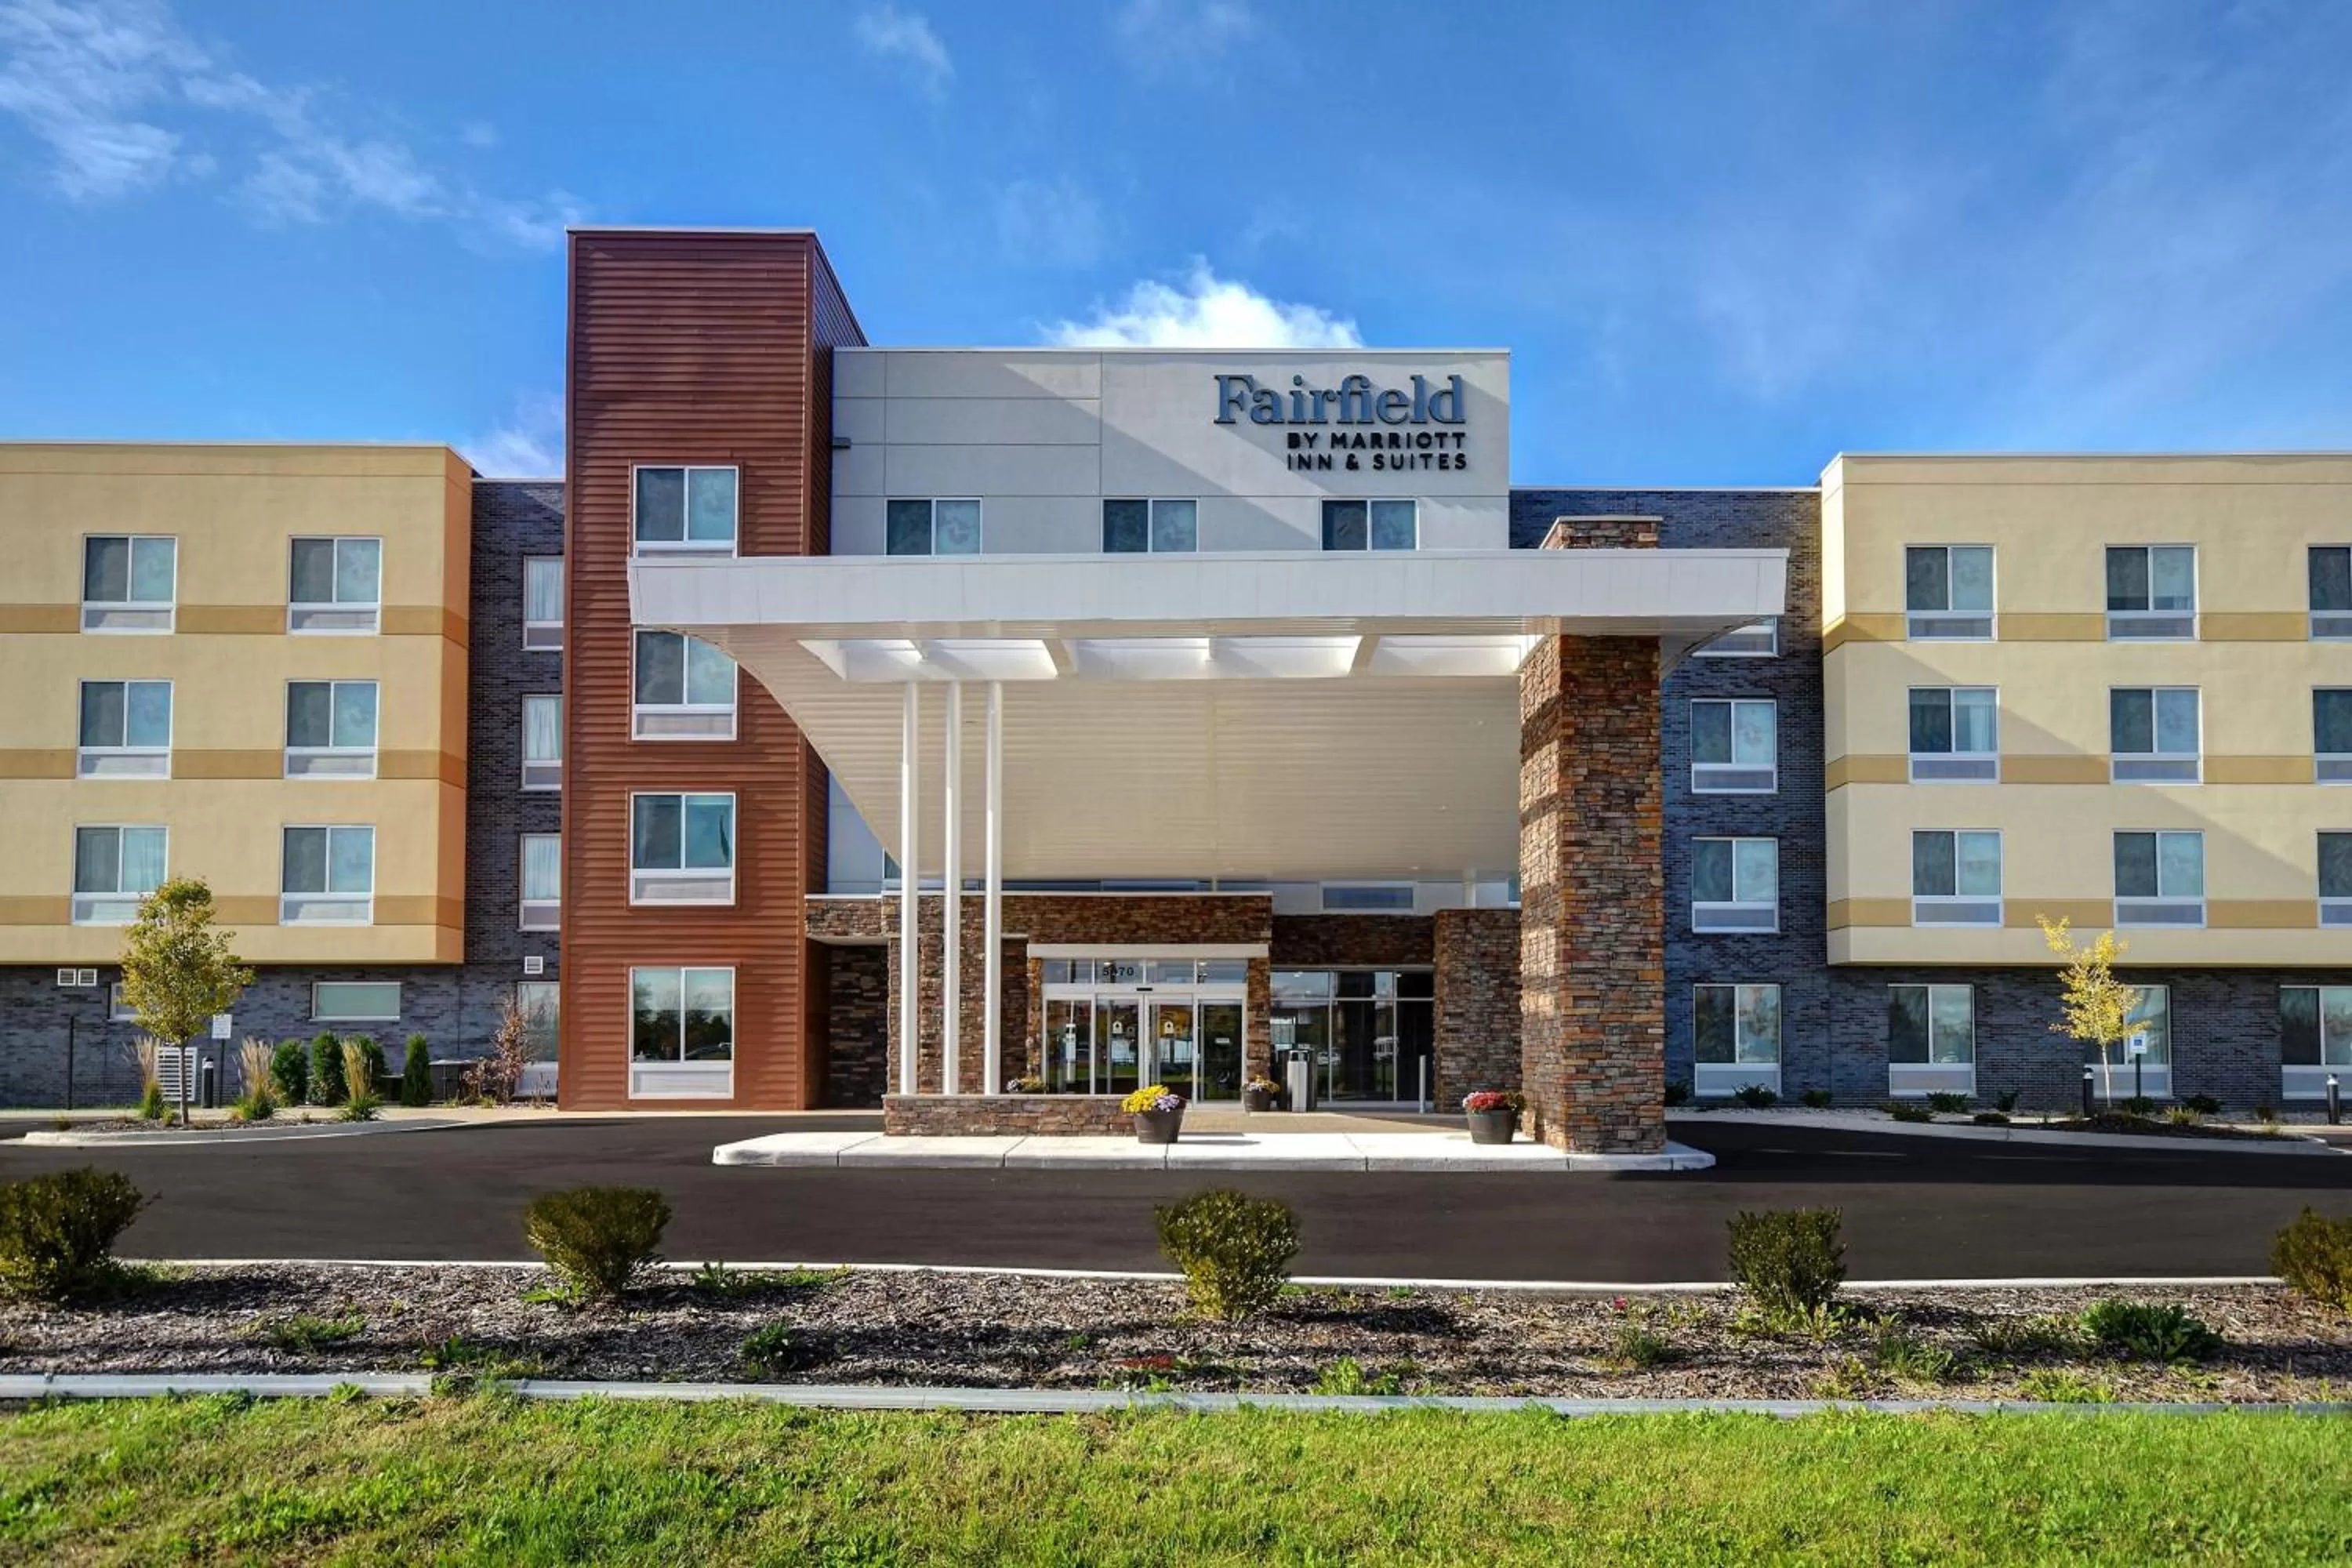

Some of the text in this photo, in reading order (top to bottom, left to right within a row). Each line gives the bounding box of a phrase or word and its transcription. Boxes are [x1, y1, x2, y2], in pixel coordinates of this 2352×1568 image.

[1214, 374, 1466, 424] Fairfield
[1287, 432, 1466, 449] BY MARRIOTT
[1287, 453, 1468, 470] INN & SUITES
